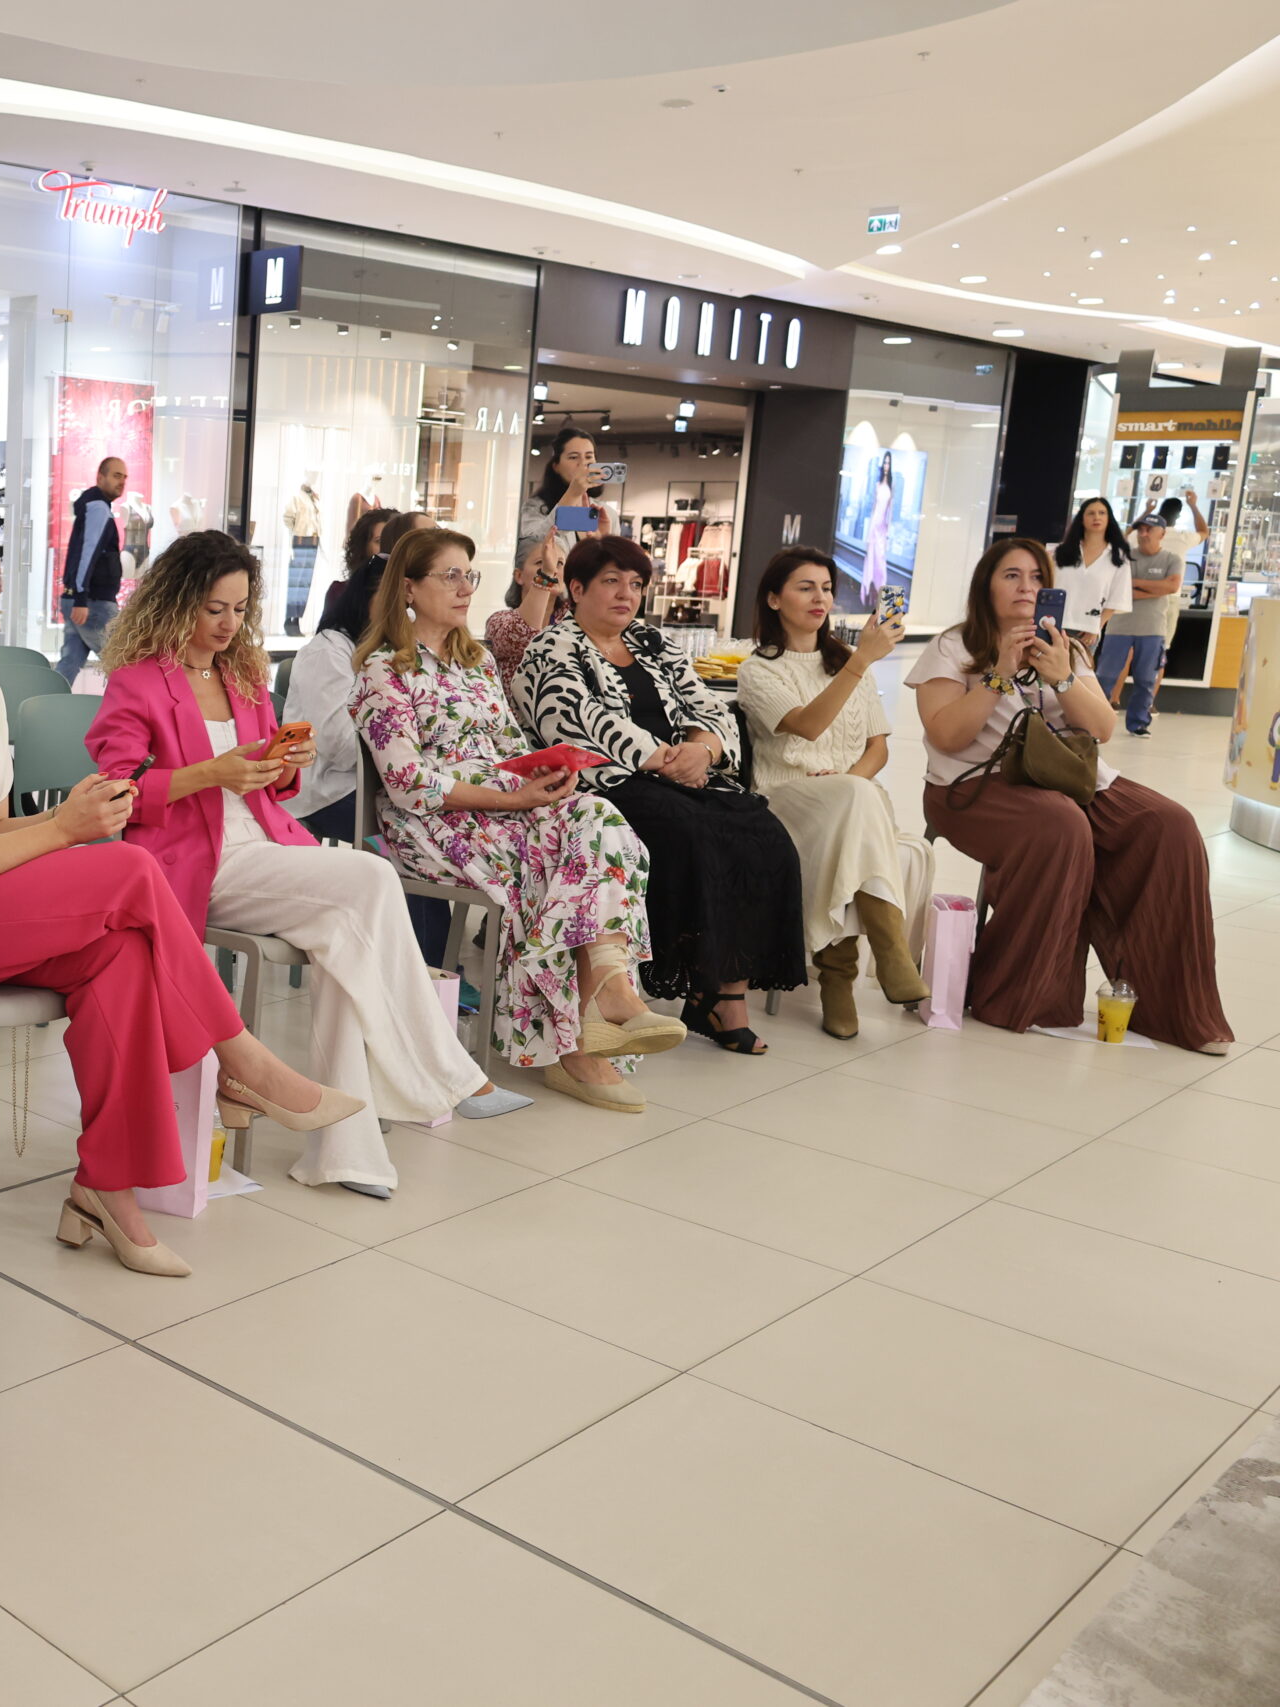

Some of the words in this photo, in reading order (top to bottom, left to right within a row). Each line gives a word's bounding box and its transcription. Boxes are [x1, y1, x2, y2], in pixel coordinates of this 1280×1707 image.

[38, 169, 168, 248] Triumph
[264, 256, 284, 299] M
[782, 514, 801, 544] M
